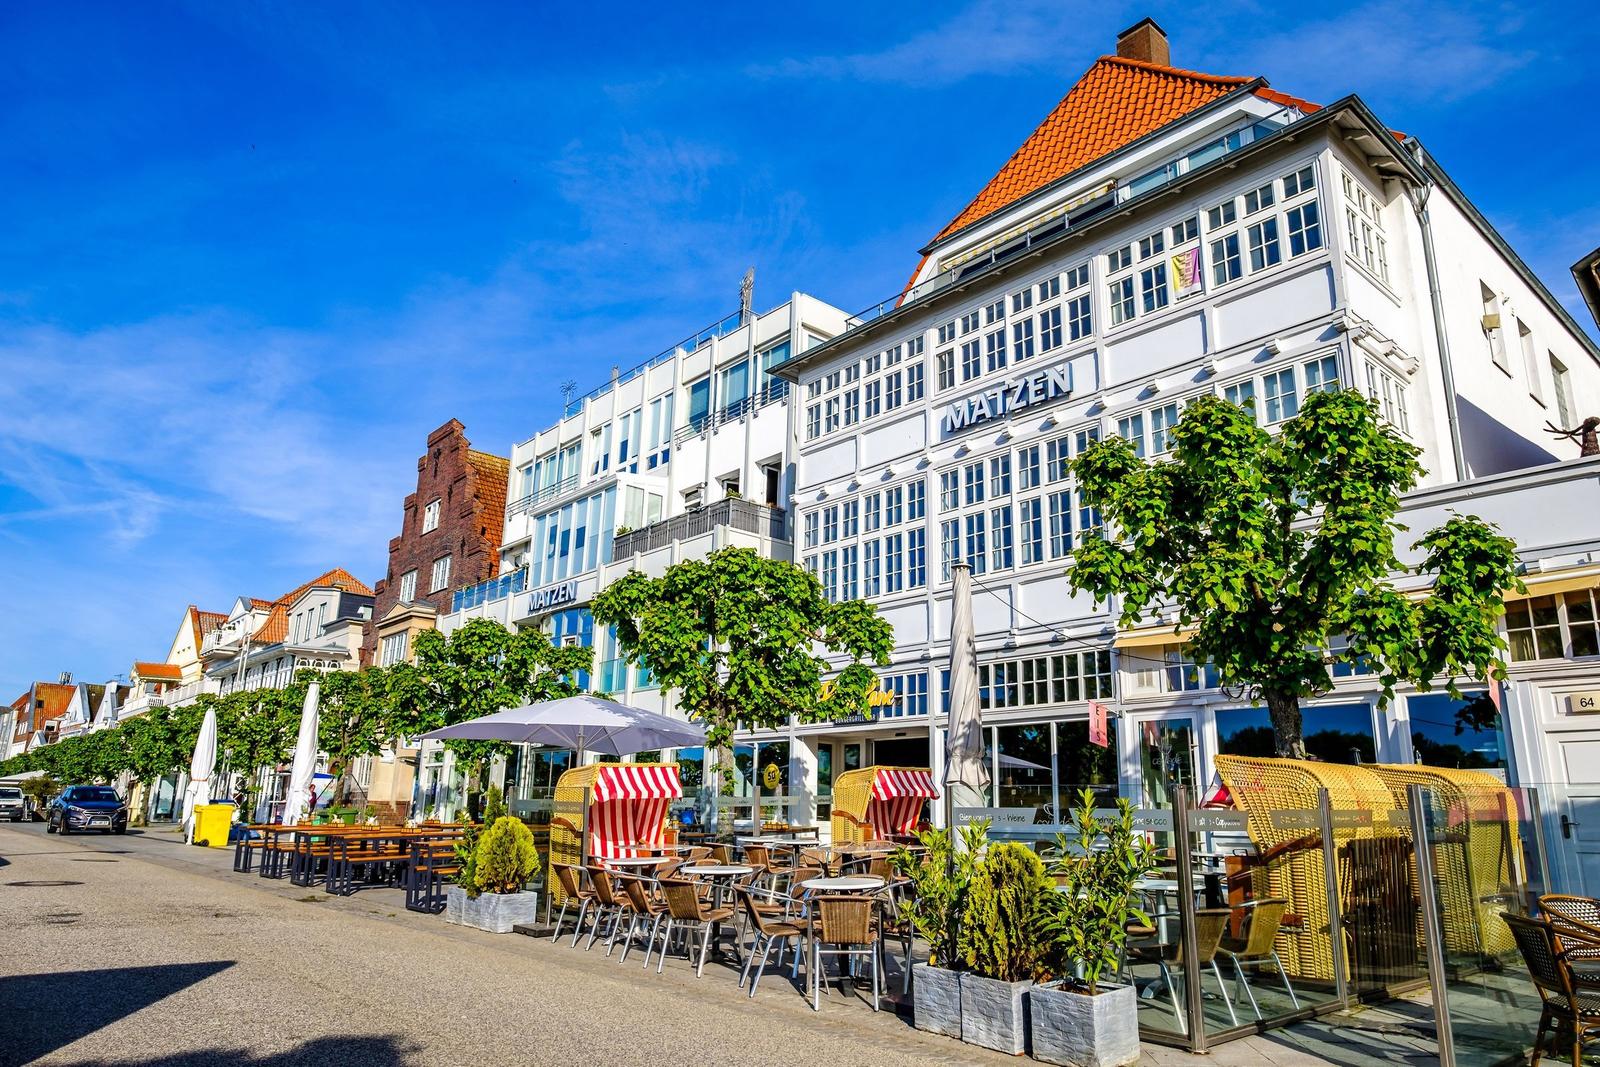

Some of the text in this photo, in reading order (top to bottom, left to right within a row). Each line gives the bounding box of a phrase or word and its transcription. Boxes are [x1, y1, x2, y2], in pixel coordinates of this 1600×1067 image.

[946, 361, 1072, 432] MATZEN
[528, 580, 578, 611] MATZEN
[1580, 697, 1595, 708] 64
